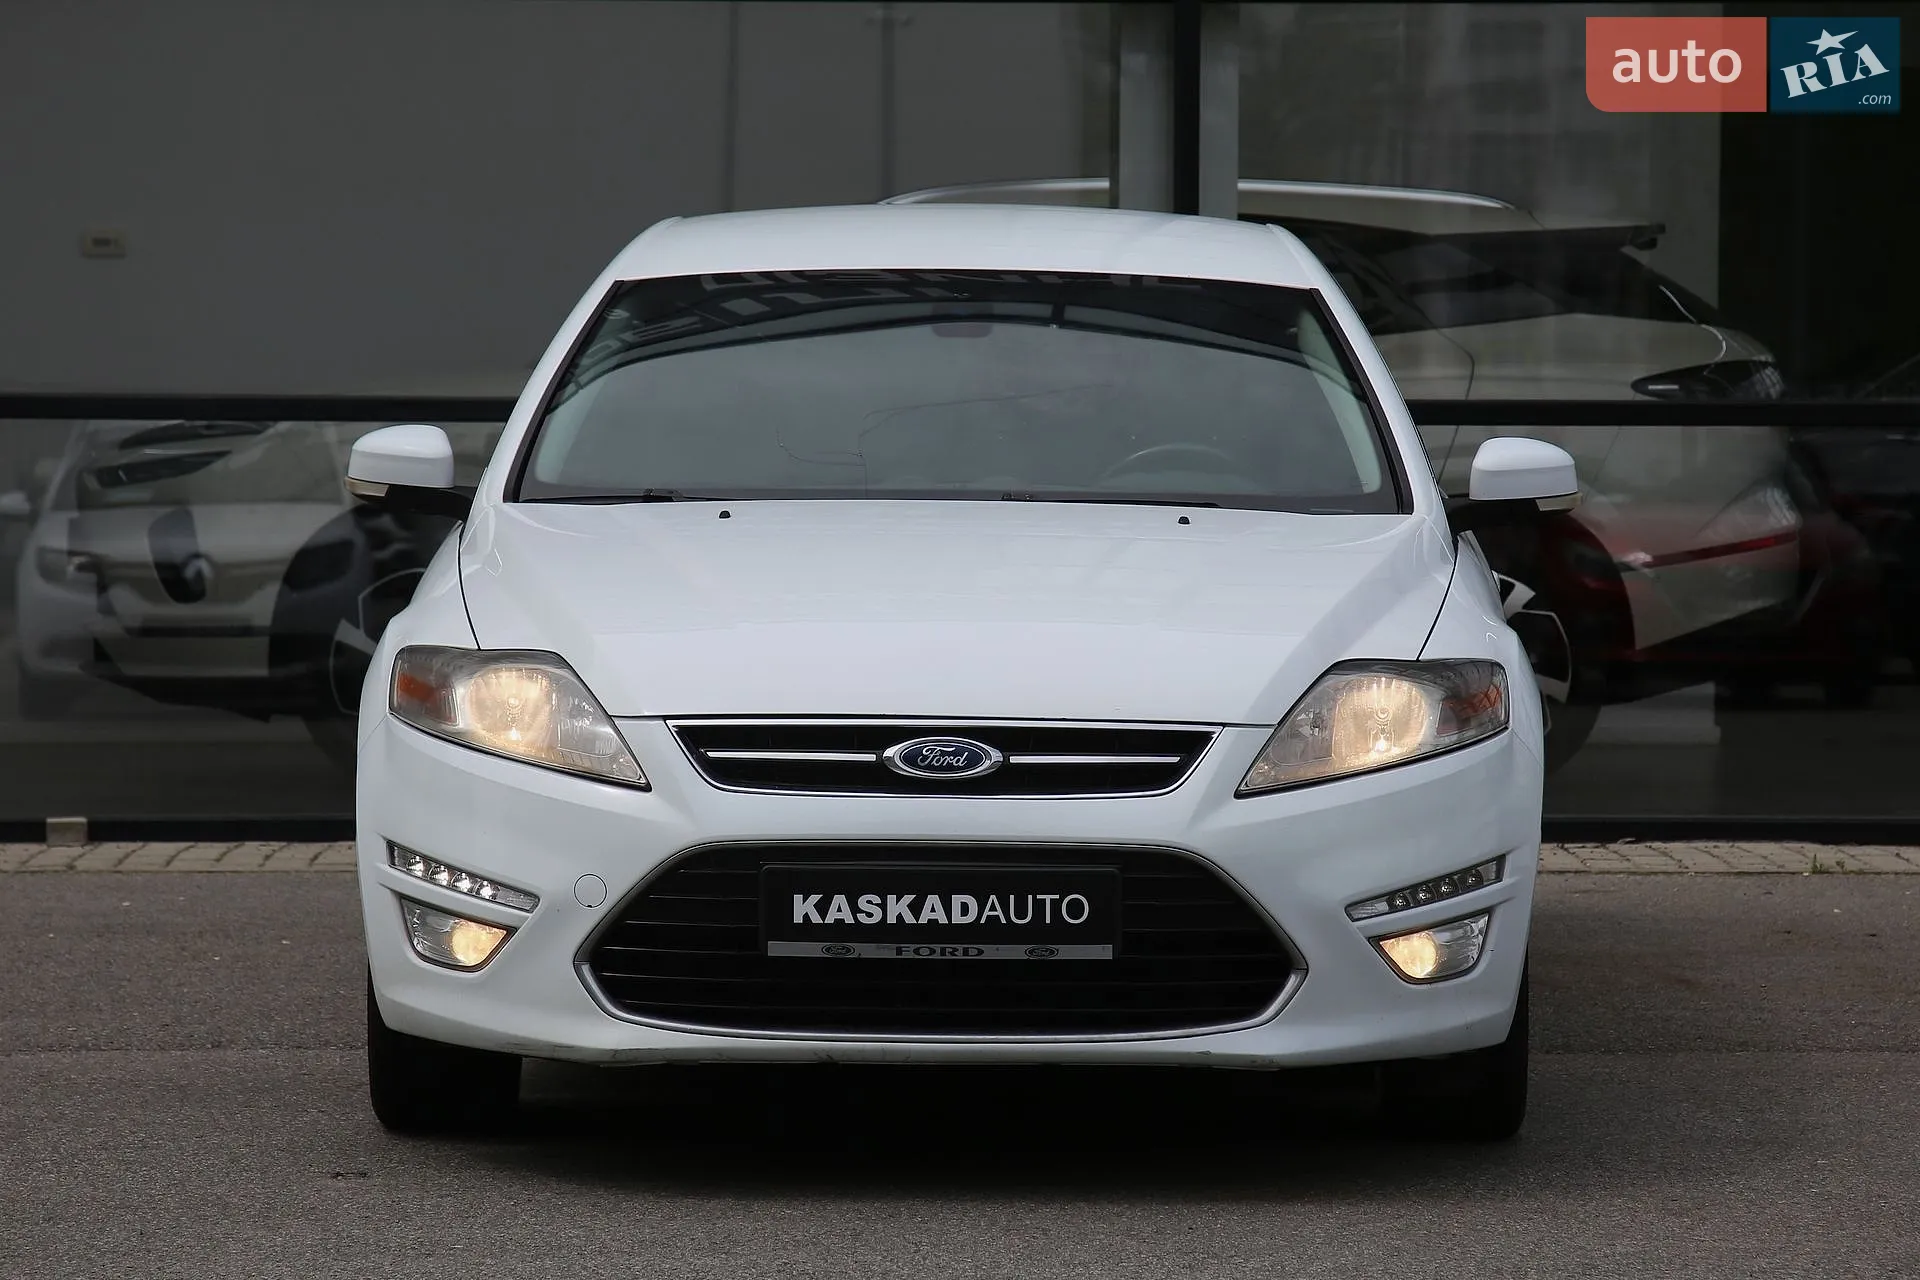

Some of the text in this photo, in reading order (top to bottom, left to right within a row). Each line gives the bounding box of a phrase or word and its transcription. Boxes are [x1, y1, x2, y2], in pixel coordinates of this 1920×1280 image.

[917, 745, 969, 767] Ford
[792, 893, 1090, 925] KASKADAUTO
[894, 945, 985, 958] FORD
